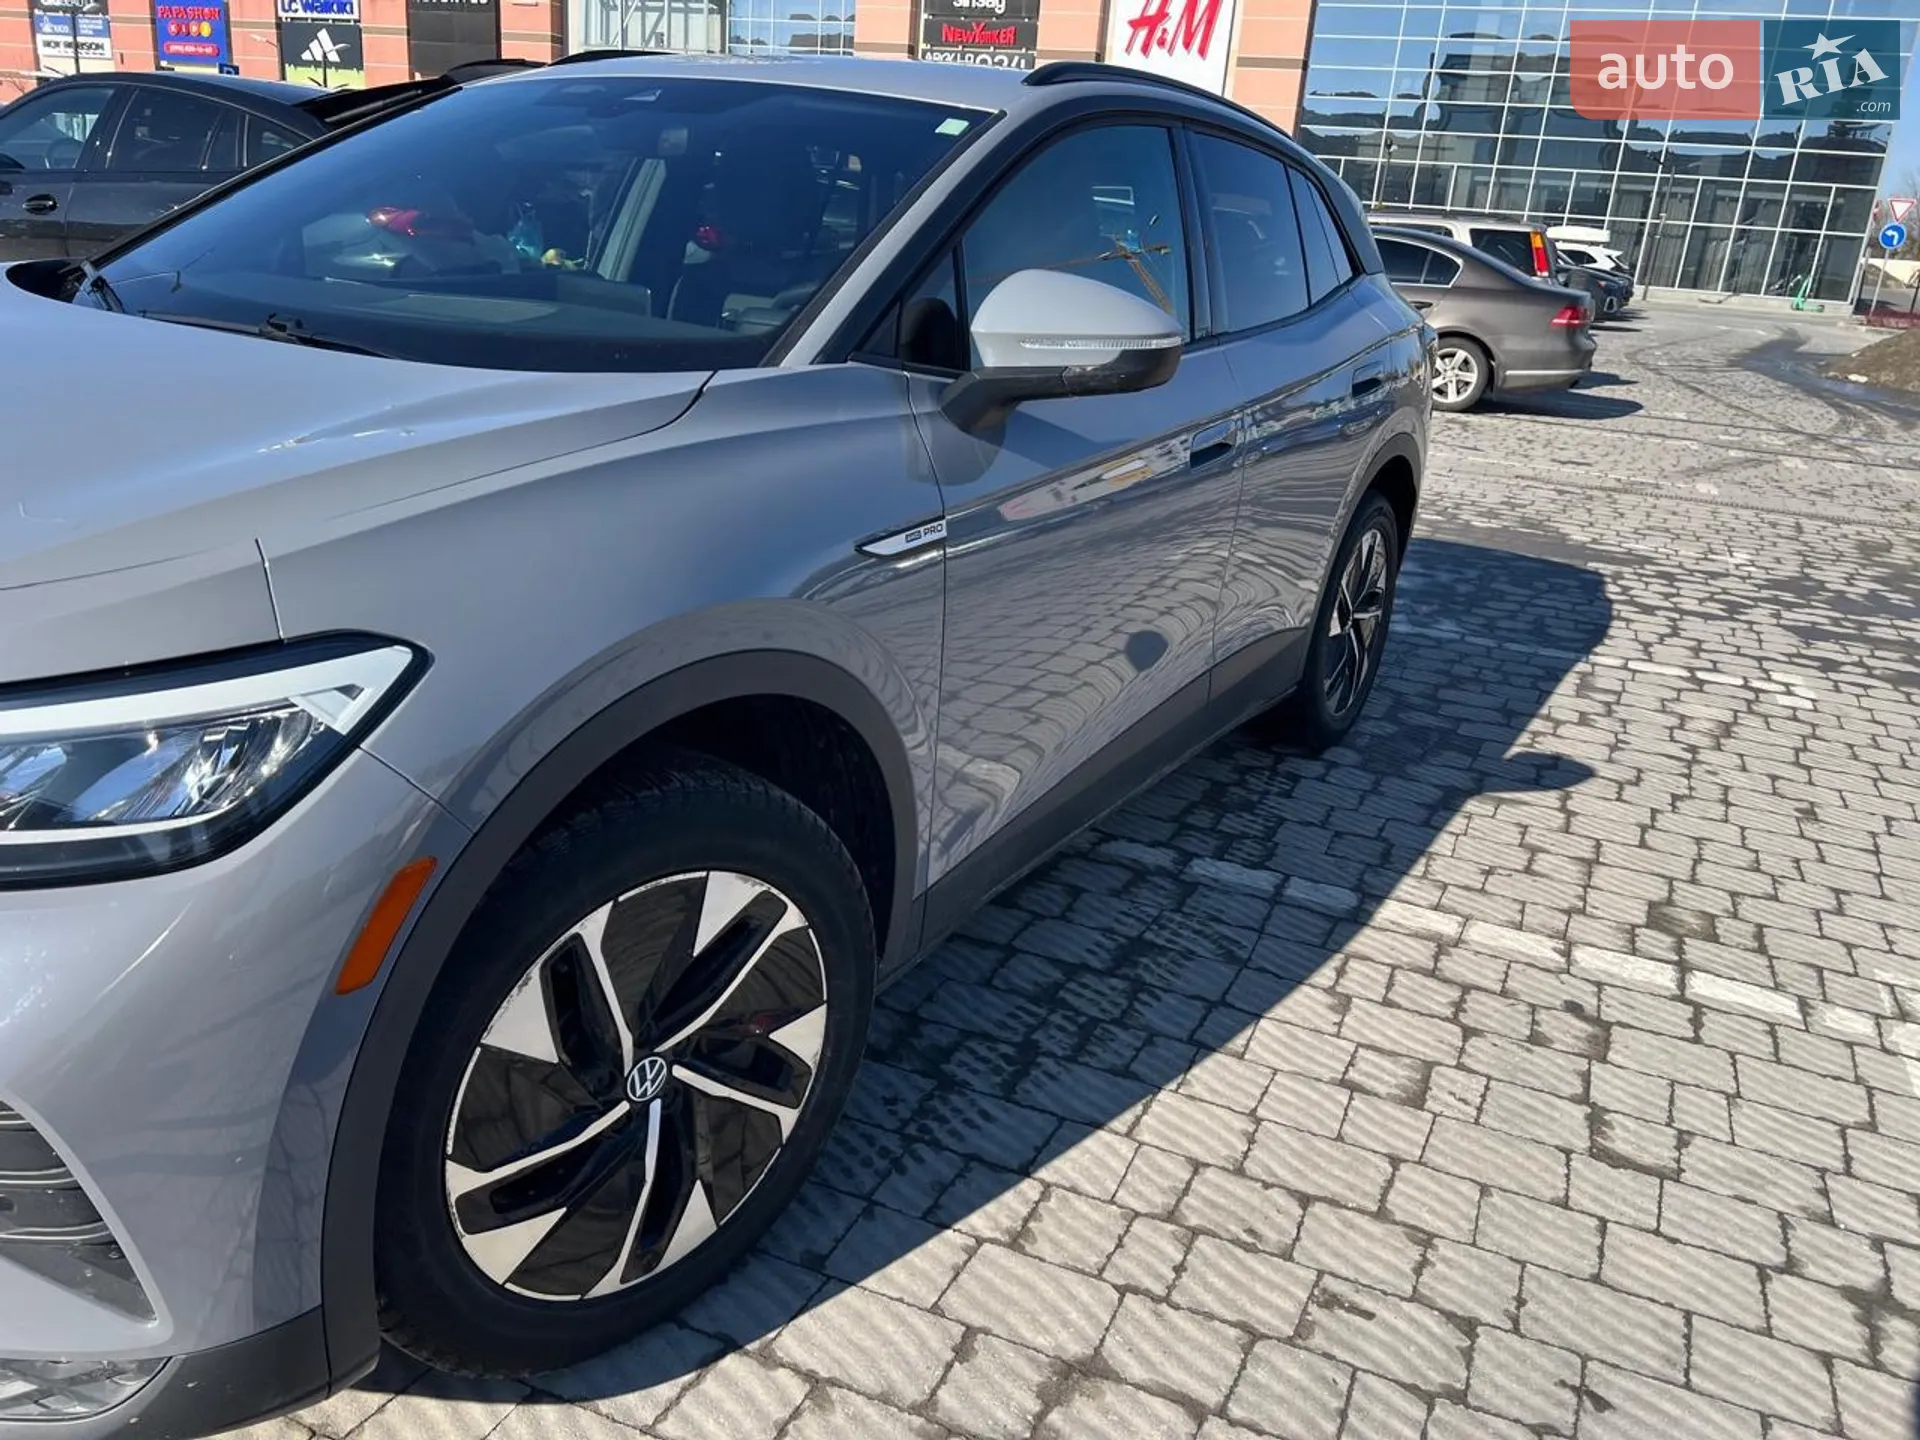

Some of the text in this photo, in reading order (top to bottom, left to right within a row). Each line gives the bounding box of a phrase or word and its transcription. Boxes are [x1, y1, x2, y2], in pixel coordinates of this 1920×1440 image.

[157, 5, 221, 20] PAPASHON
[1128, 0, 1222, 60] H&M
[924, 523, 943, 536] PRO
